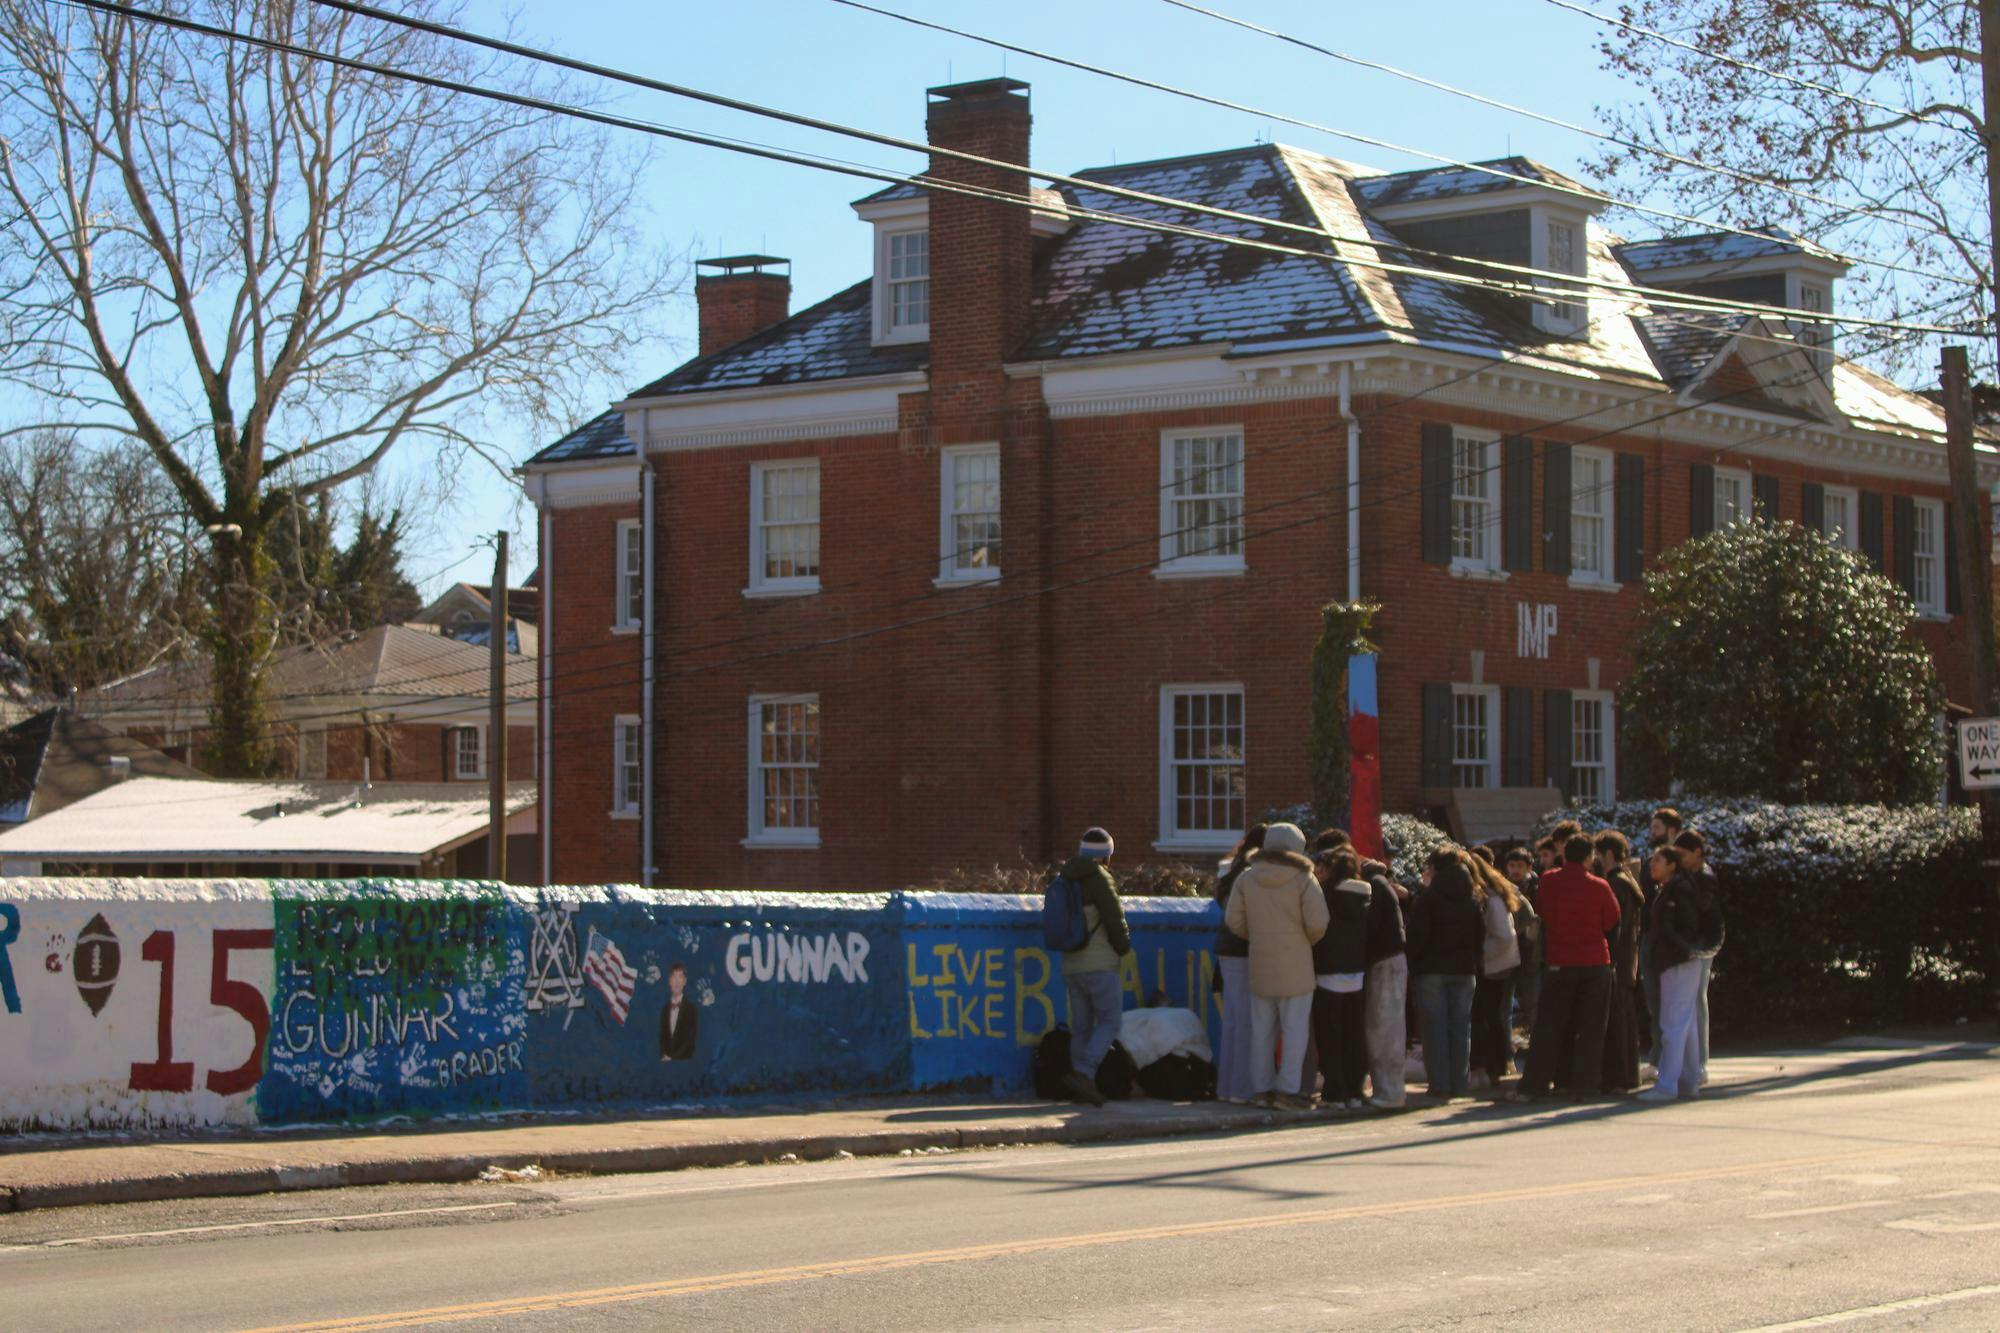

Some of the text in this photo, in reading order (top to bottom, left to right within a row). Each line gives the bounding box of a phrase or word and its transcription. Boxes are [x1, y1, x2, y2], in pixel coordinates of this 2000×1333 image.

[1517, 602, 1558, 660] IMP
[1967, 725, 2000, 741] ONE
[1967, 744, 2000, 761] WAY
[725, 931, 871, 987] GUNNAR
[907, 943, 1006, 988] LIVE
[129, 928, 275, 1097] 15
[283, 989, 460, 1059] GUNNAR
[908, 989, 1007, 1040] LIKE
